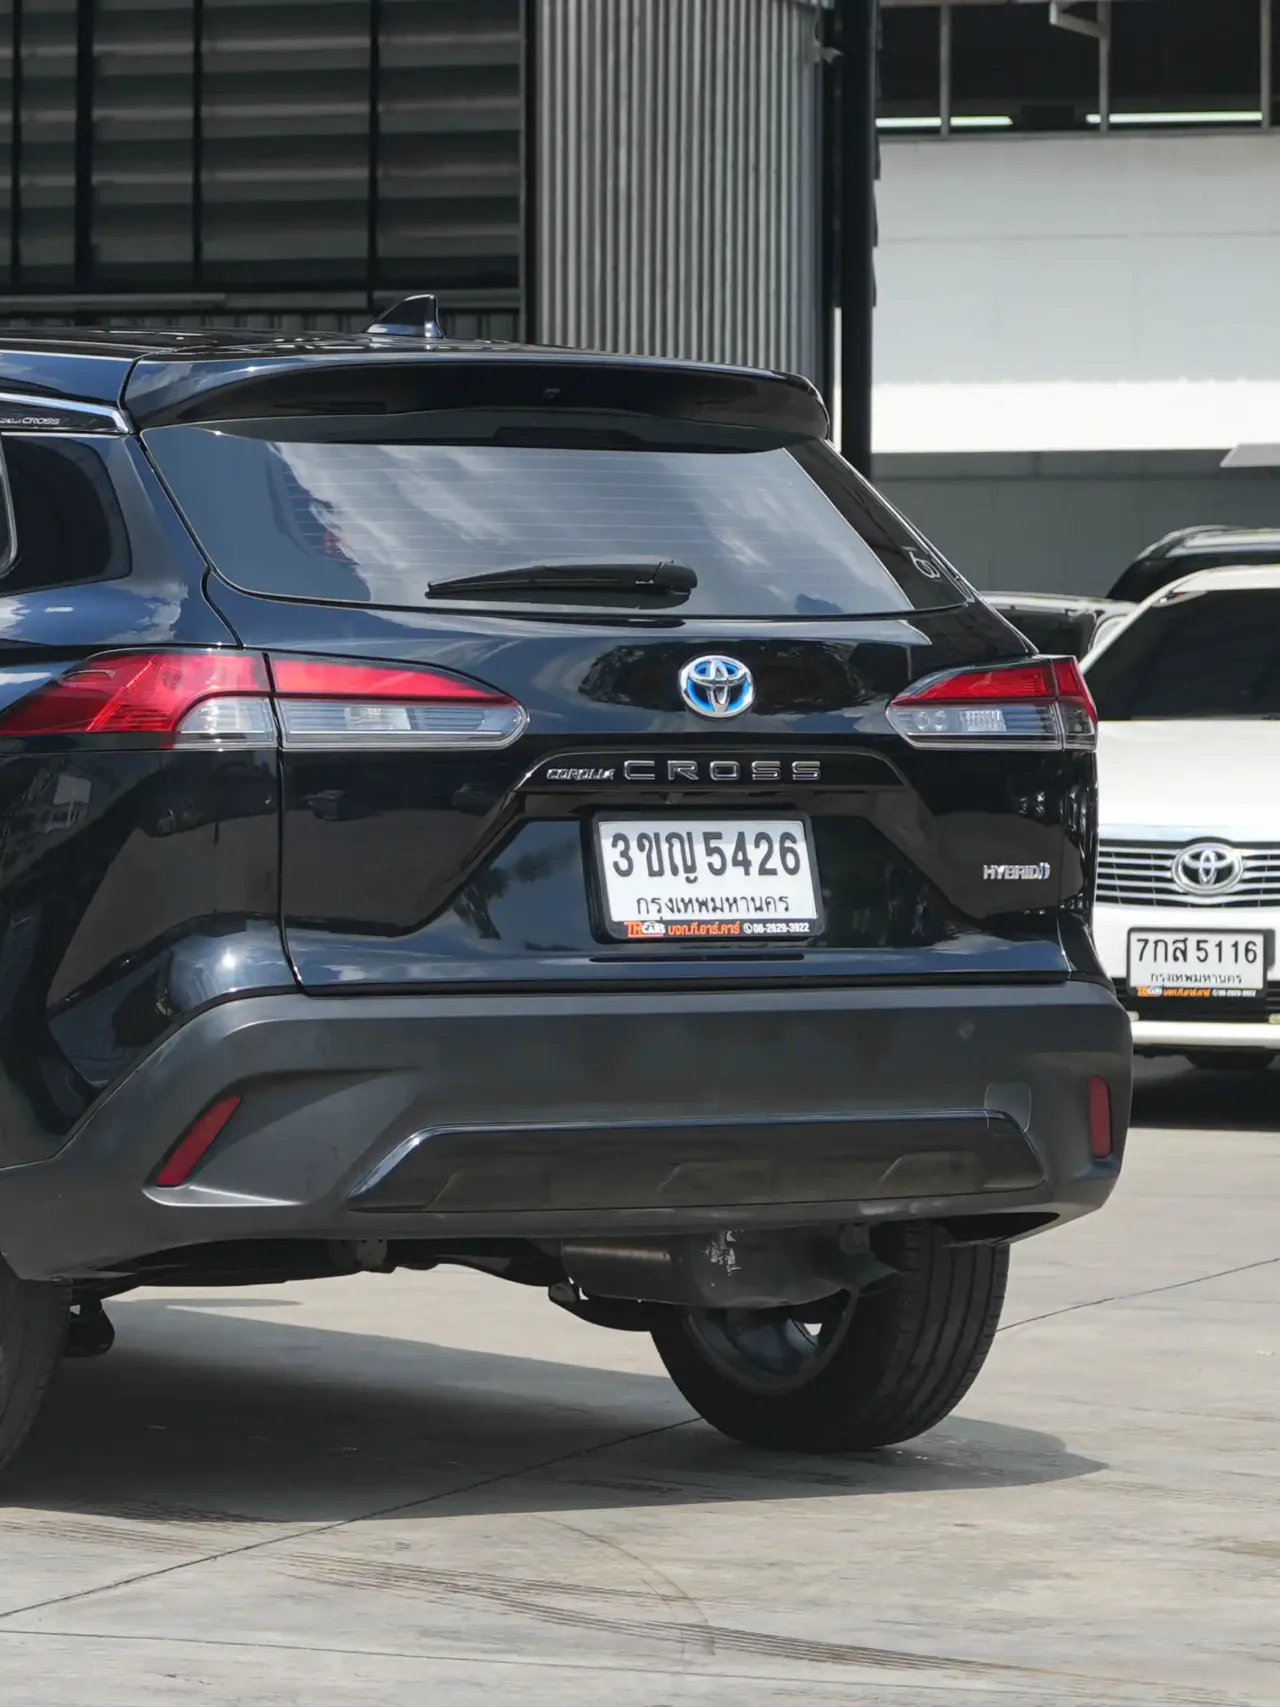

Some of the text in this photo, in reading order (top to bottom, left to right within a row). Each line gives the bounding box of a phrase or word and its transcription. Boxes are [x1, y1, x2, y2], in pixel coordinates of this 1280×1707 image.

[546, 760, 821, 780] COROLLA CROSS
[611, 831, 801, 884] 3ขญ 5426
[982, 864, 1041, 880] HYBRID
[636, 895, 790, 921] กรุงเทพมหานคร
[1136, 937, 1258, 964] 7กส 5116
